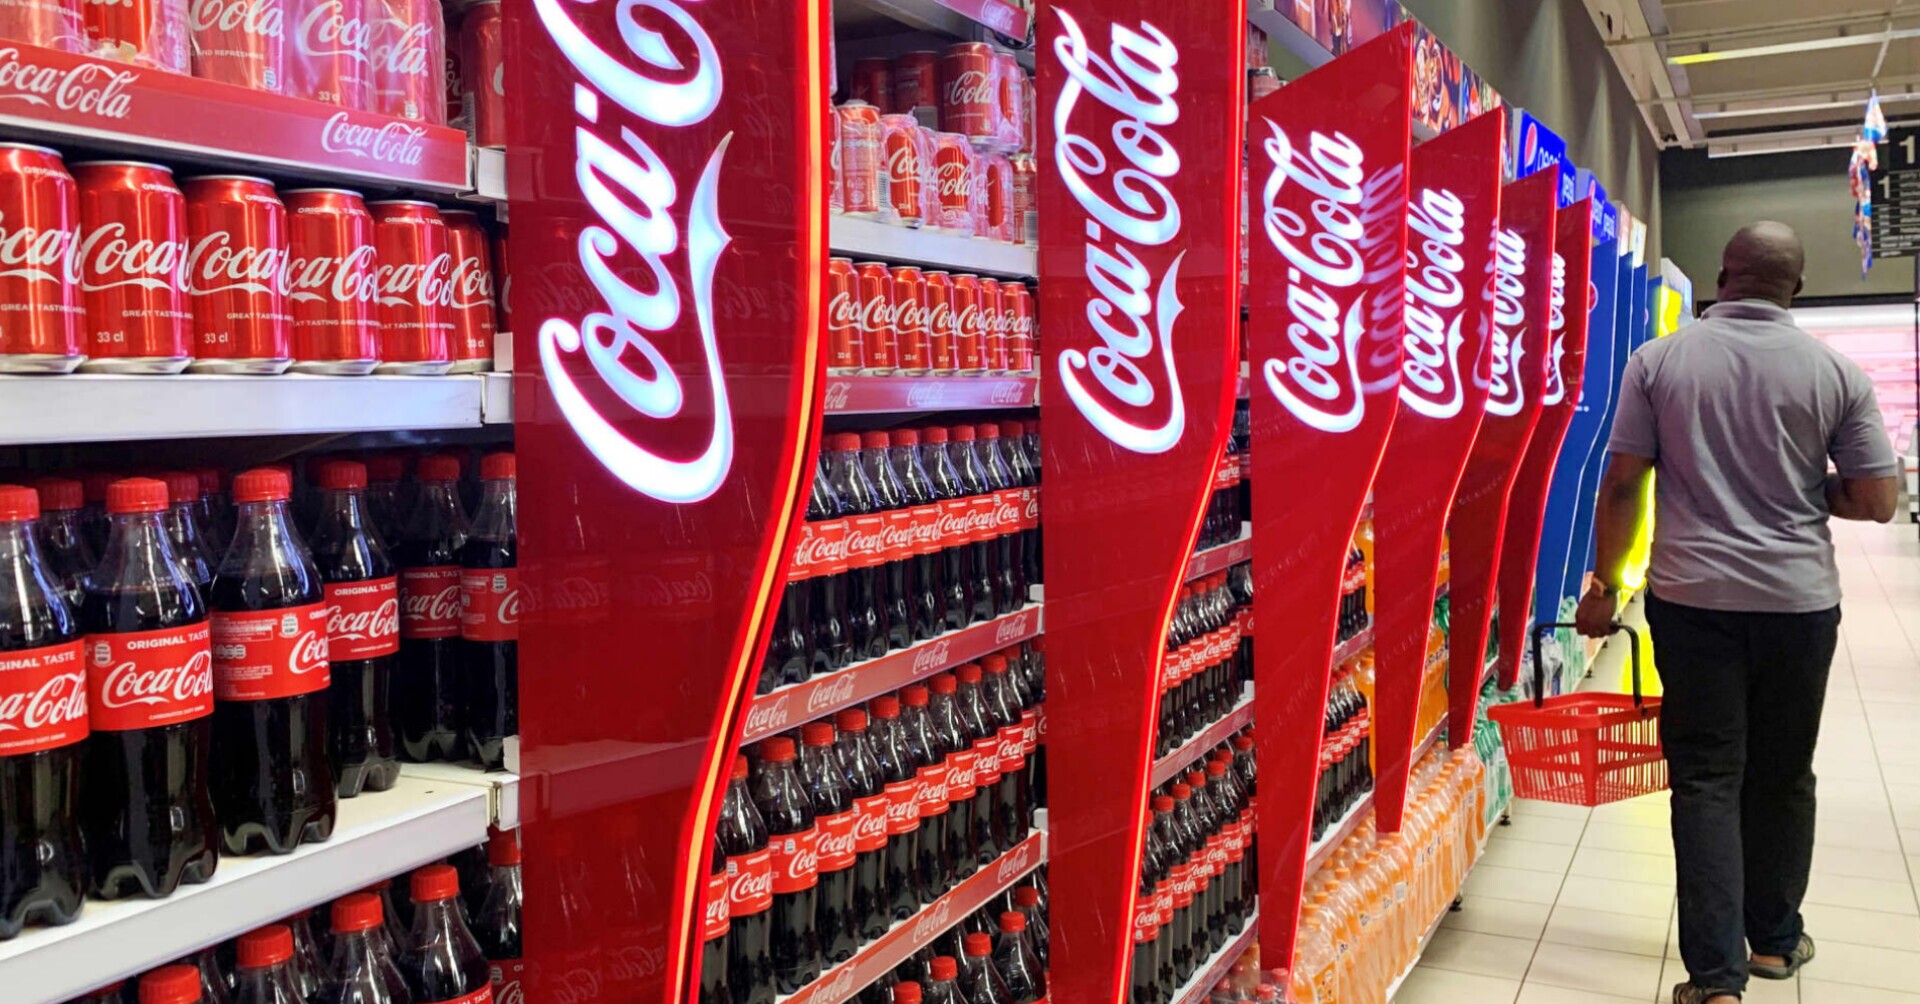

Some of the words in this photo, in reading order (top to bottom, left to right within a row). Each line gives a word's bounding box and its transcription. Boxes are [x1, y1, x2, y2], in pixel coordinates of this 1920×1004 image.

[321, 111, 428, 166] Coca-Cola
[1898, 134, 1915, 164] 1
[1049, 4, 1187, 454] Coca-Cola
[1260, 115, 1369, 433] Coca-Cola
[96, 331, 112, 344] 33
[113, 331, 125, 343] cl
[204, 332, 217, 344] 33
[218, 332, 229, 344] cl
[334, 585, 379, 597] ORIGINAL
[42, 651, 76, 666] TASTE
[126, 635, 187, 651] ORIGINAL
[913, 640, 951, 675] Coca-Cola
[806, 671, 858, 714] Coca-Cola
[913, 897, 952, 944] Coca-Cola
